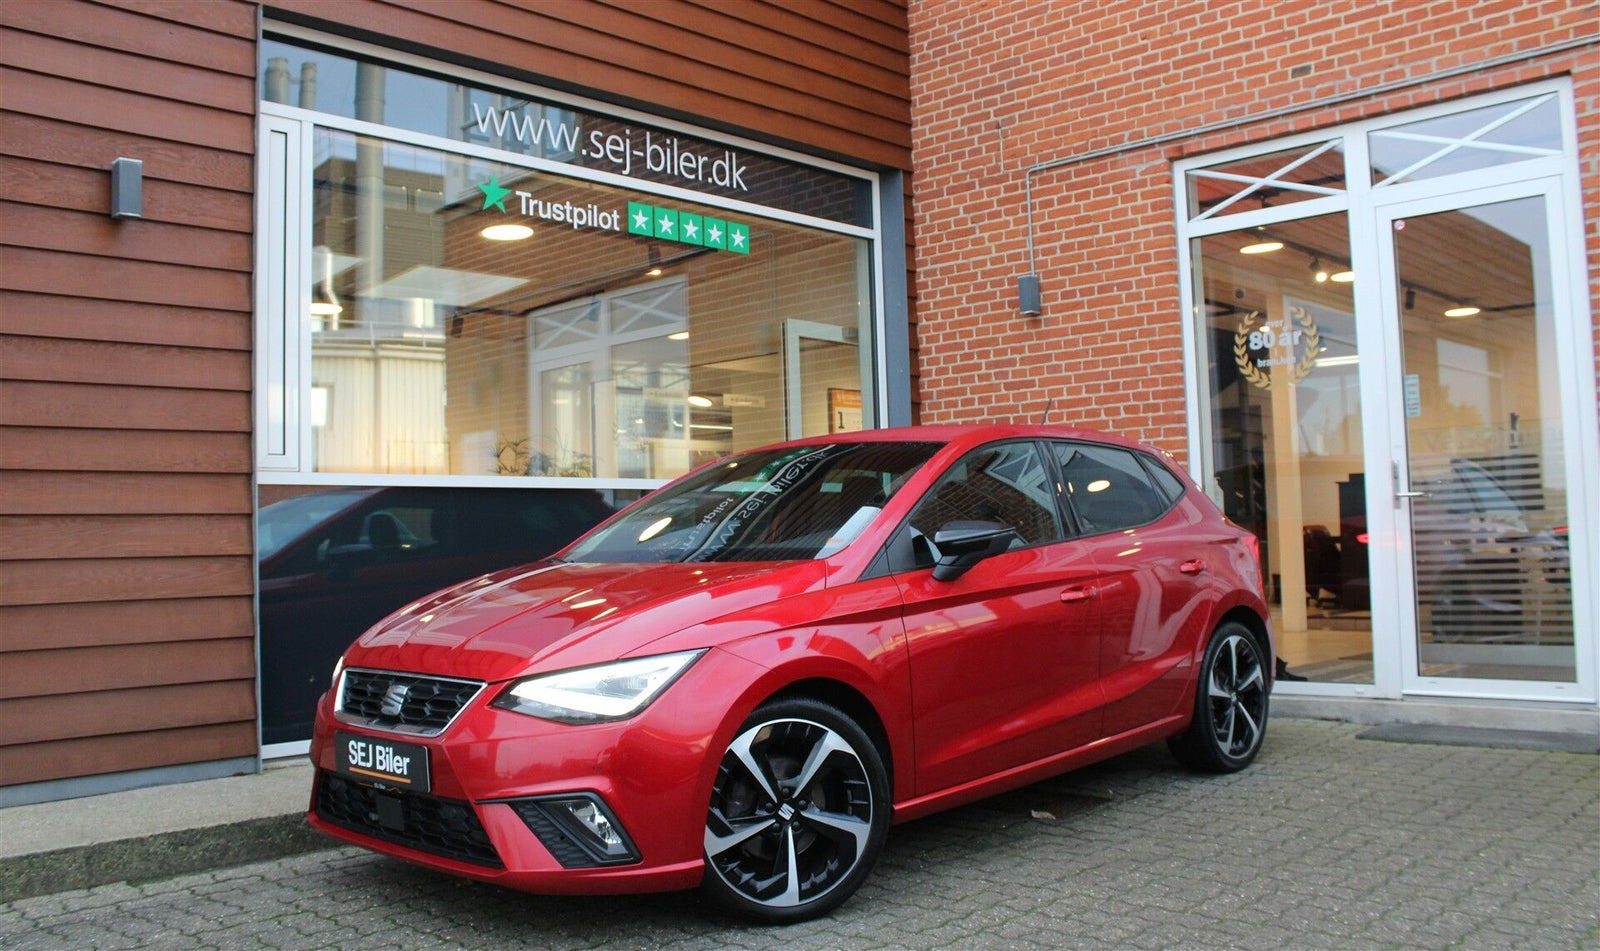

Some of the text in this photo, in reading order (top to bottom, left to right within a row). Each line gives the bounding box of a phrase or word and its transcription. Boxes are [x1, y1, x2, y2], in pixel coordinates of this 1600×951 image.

[473, 102, 748, 192] www.sej-biler.dk
[515, 190, 620, 232] Trustpilot
[1249, 325, 1302, 350] 80 år
[348, 739, 411, 776] SEJ Biler
